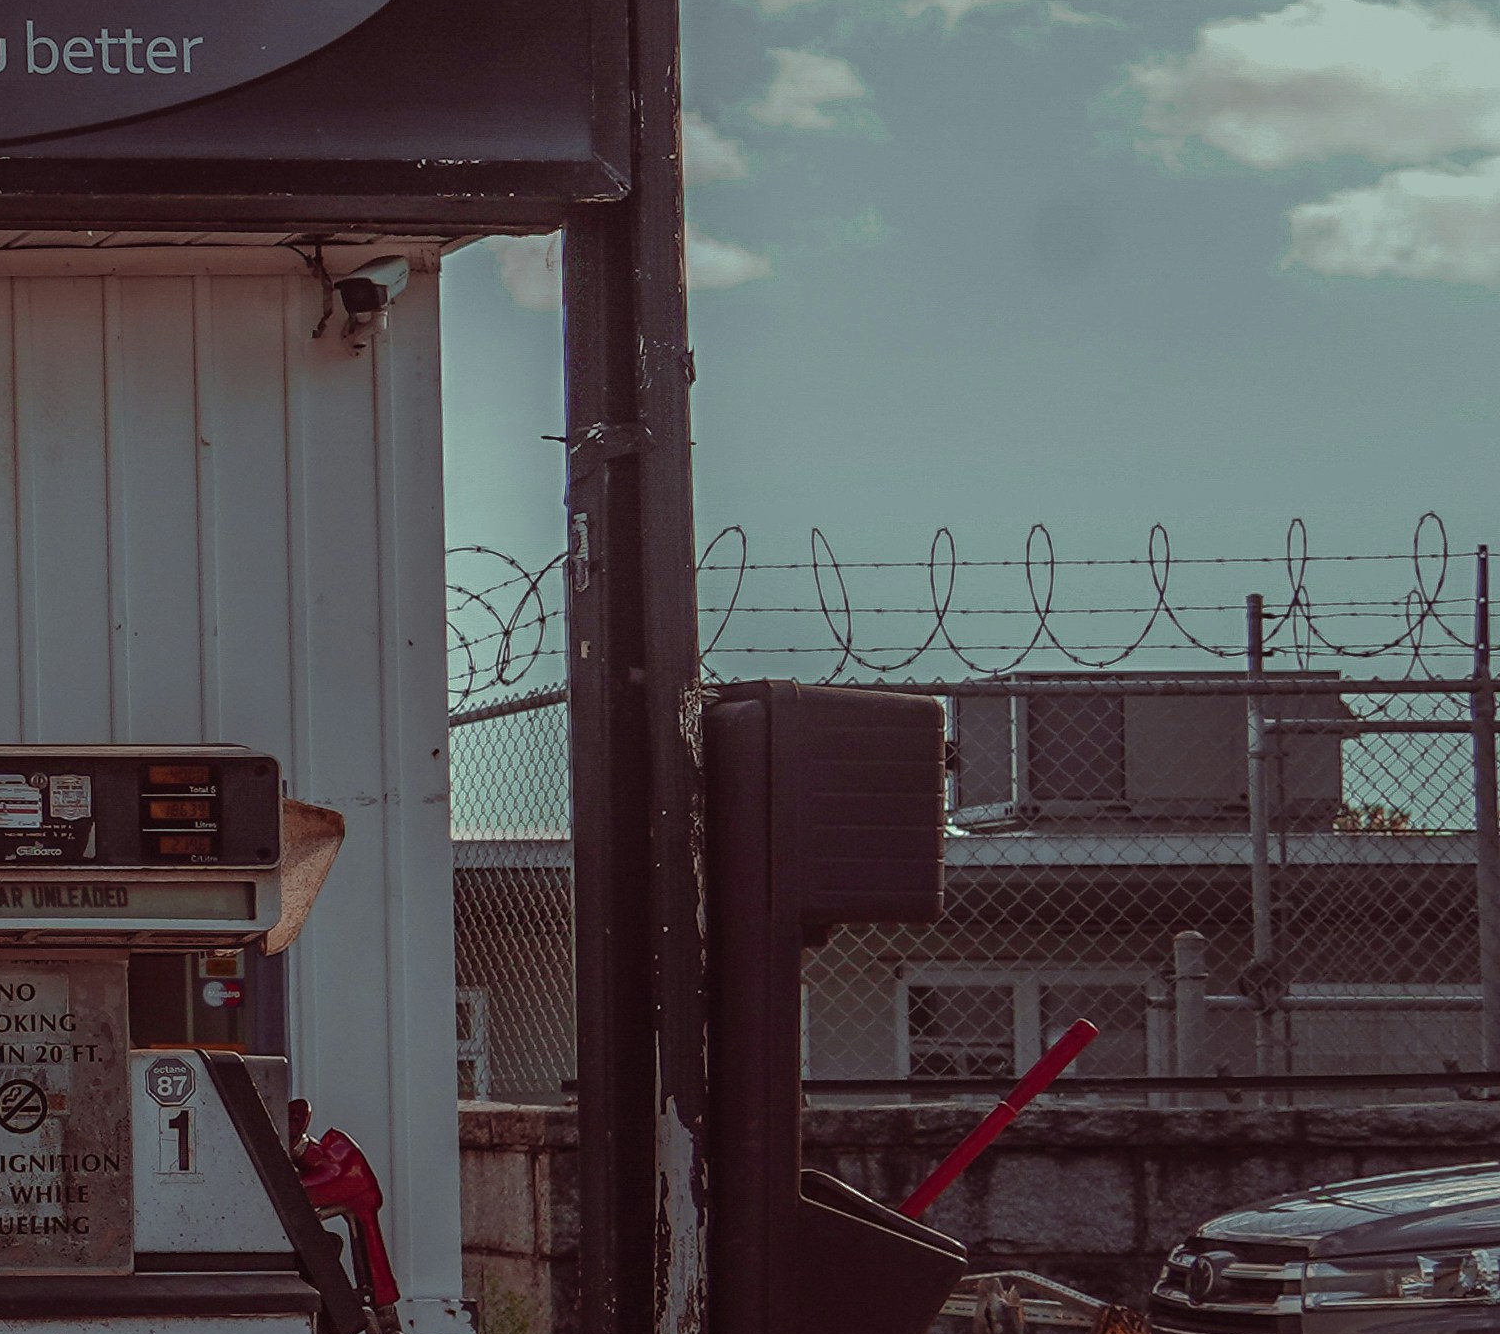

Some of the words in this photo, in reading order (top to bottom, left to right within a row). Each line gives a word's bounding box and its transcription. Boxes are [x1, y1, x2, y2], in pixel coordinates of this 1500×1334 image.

[24, 20, 205, 76] better
[188, 785, 209, 794] Total
[194, 821, 217, 829] Litres
[31, 885, 129, 908] UNLEADED
[35, 1045, 63, 1064] 20
[72, 1045, 103, 1063] FT.
[153, 1066, 187, 1074] octane
[156, 1075, 188, 1097] 87
[168, 1110, 190, 1171] 1
[0, 1153, 120, 1173] IGNITION
[9, 1185, 89, 1204] WHILE
